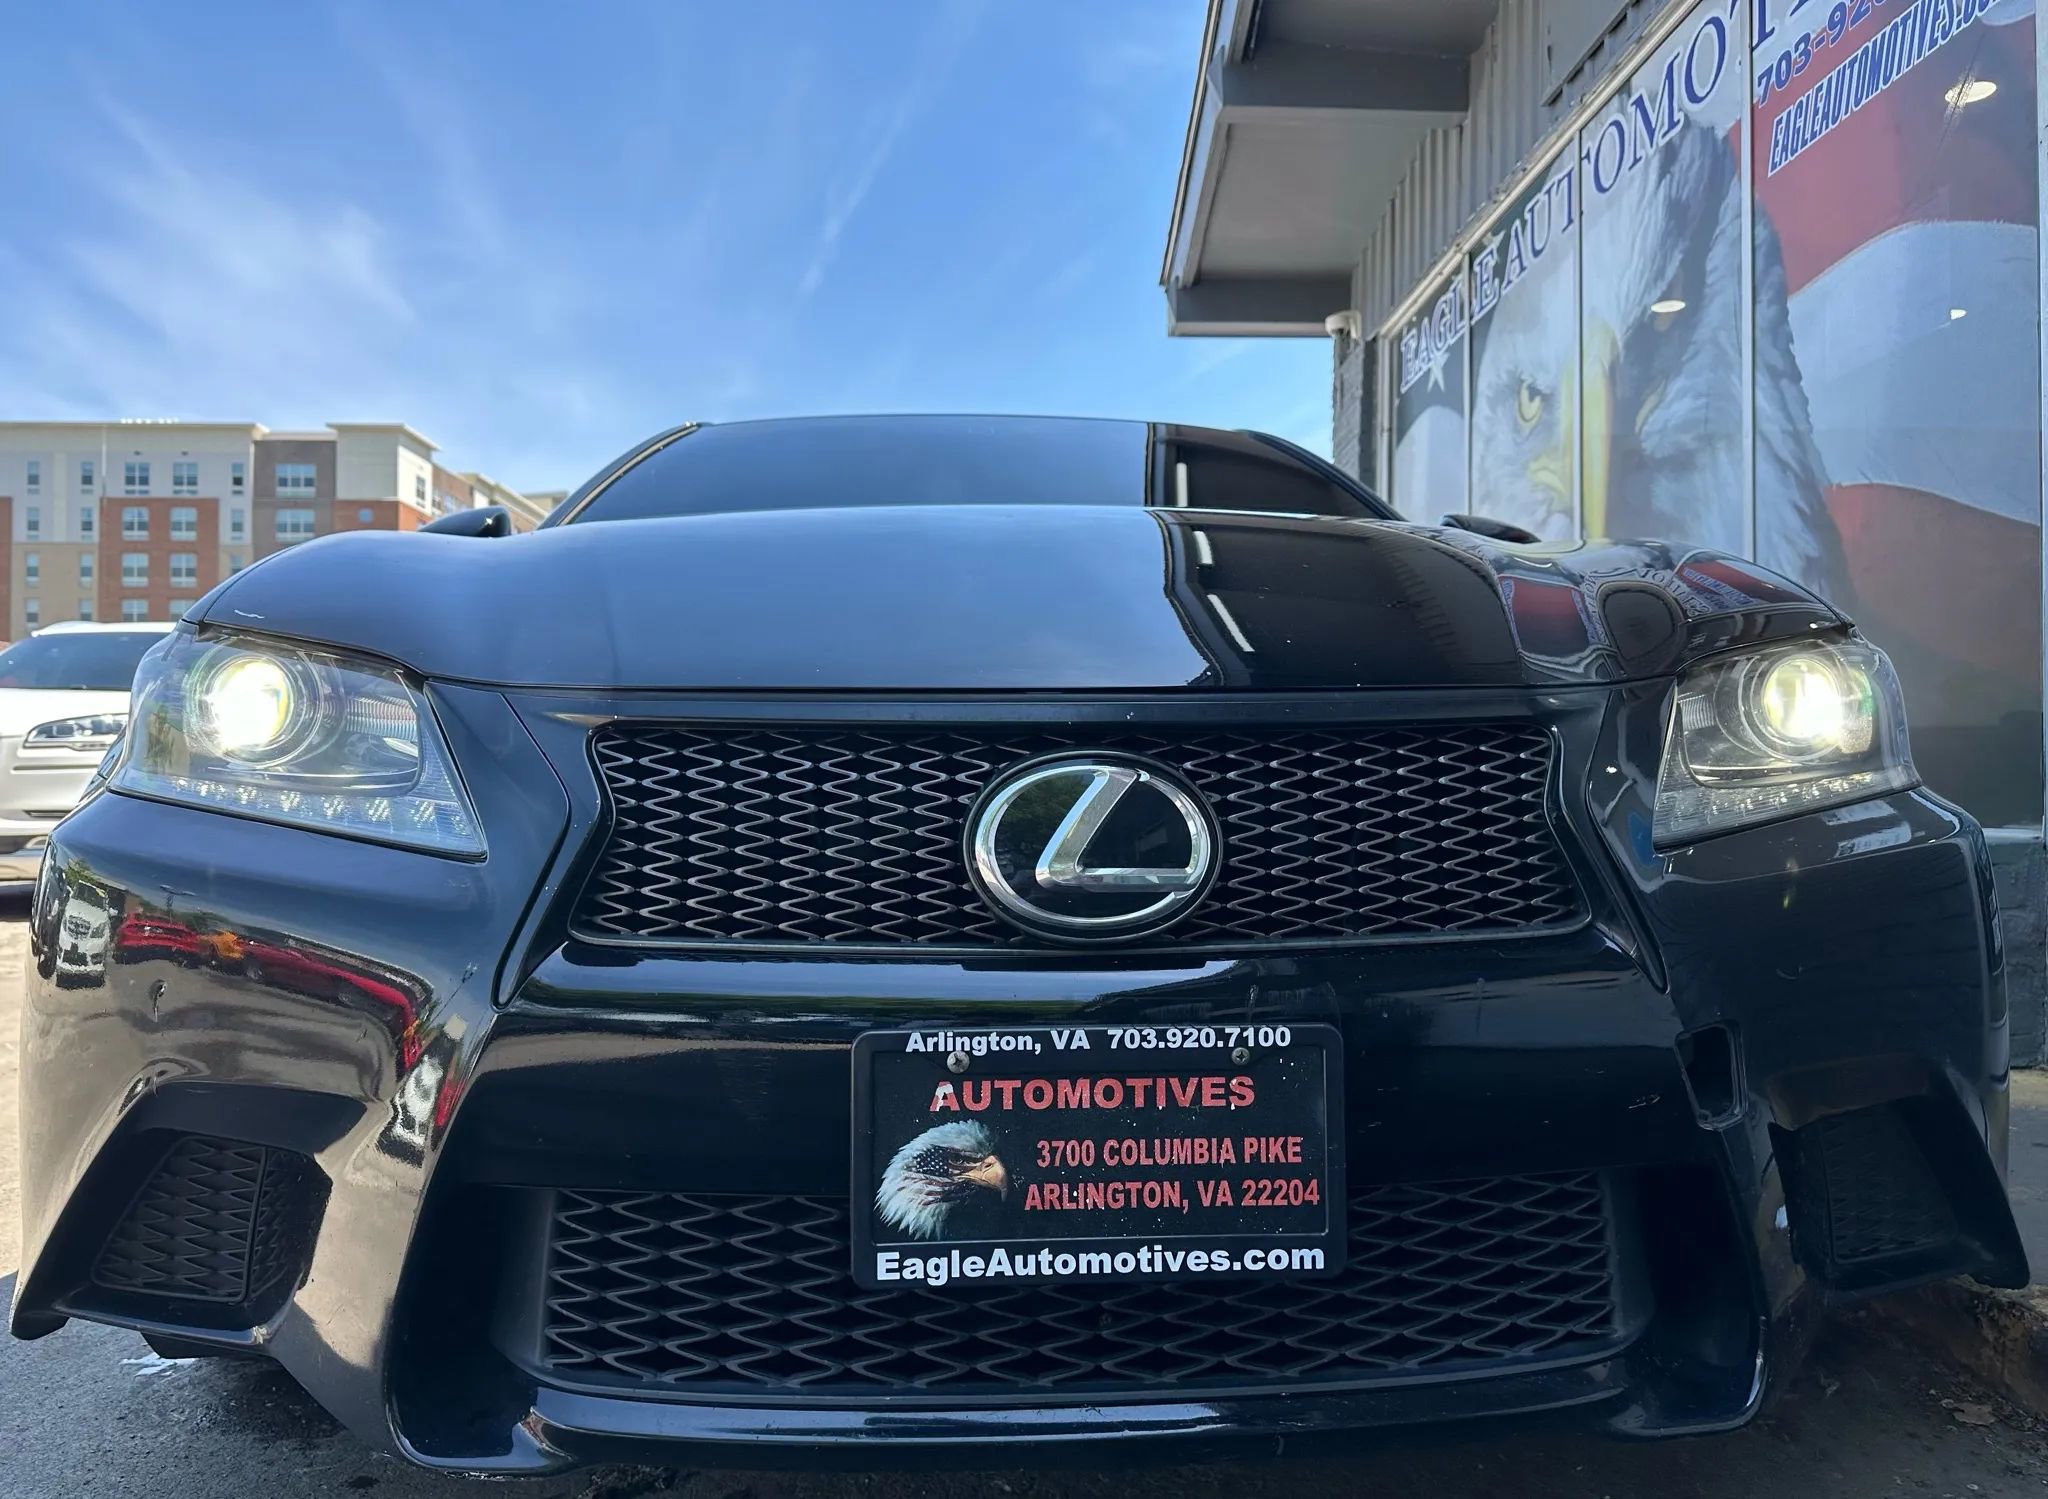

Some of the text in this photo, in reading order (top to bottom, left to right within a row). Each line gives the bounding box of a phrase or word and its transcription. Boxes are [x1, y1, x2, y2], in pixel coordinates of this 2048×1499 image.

[1757, 0, 1886, 108] 703-92
[1401, 0, 1809, 394] EAGLE AUTOMOT
[905, 1026, 1291, 1056] Arlington, VA 703.920.7100
[929, 1076, 1255, 1112] AUTOMOTIVES
[1036, 1136, 1302, 1168] 3700 COLUMBIA PIKE
[1024, 1178, 1320, 1214] ARLINGTON, VA 22204
[876, 1245, 1325, 1286] EagleAutomotives.com
